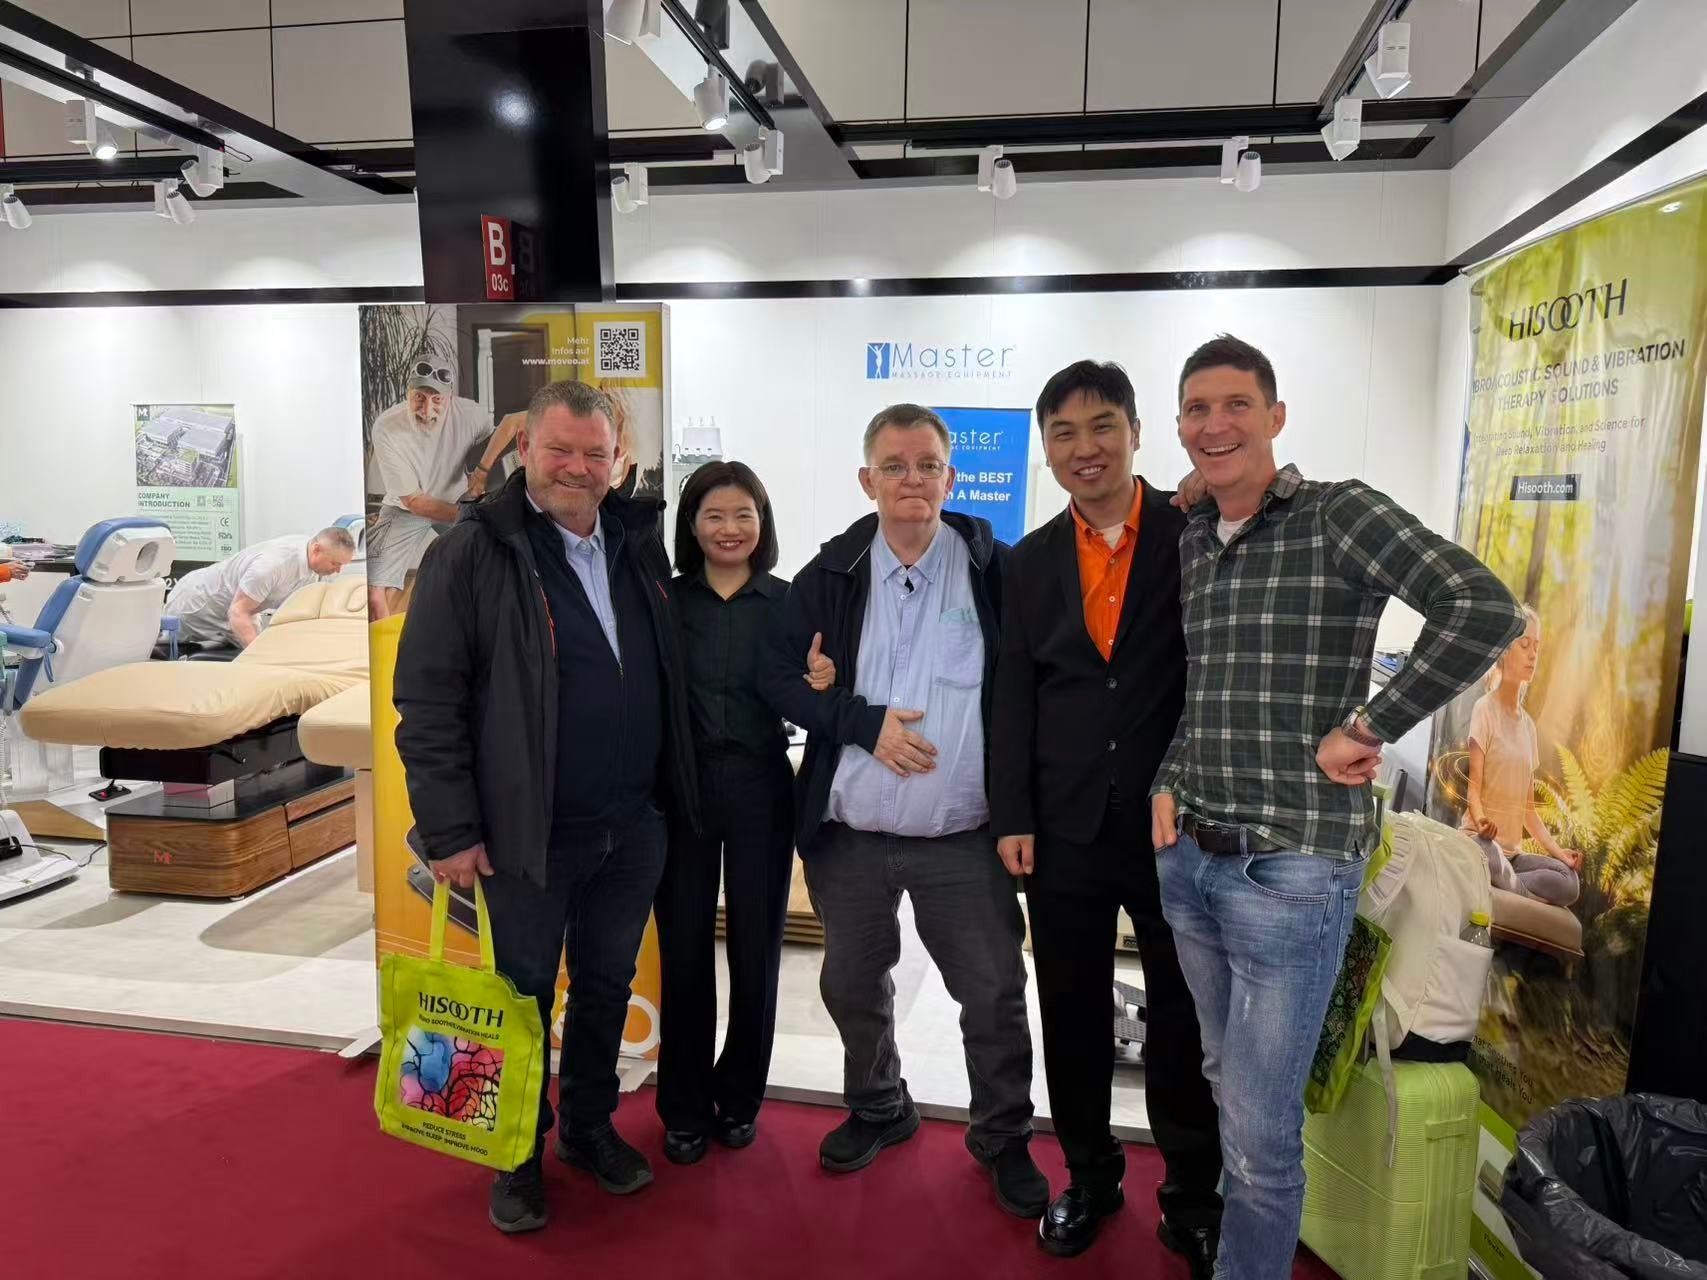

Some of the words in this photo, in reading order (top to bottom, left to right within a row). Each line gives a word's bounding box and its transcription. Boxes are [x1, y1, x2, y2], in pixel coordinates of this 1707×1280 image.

[488, 222, 506, 266] B
[492, 273, 509, 292] 03c
[1508, 279, 1627, 342] HISOOTH
[892, 342, 1014, 368] Master
[1544, 355, 1592, 380] SOUND
[1591, 352, 1600, 371] &
[1603, 339, 1685, 369] VIBRATION
[1498, 389, 1546, 411] THERAPY
[1551, 379, 1619, 402] SOLUTIONS
[1594, 419, 1628, 432] Science
[1630, 416, 1646, 427] for
[949, 429, 1002, 444] aster
[956, 471, 976, 483] the
[979, 471, 1014, 484] BEST
[1517, 480, 1574, 494] Hisooth.com
[137, 492, 170, 500] COMPANY
[957, 489, 967, 500] A
[970, 489, 1012, 502] Master
[418, 991, 504, 1028] HISOOTH
